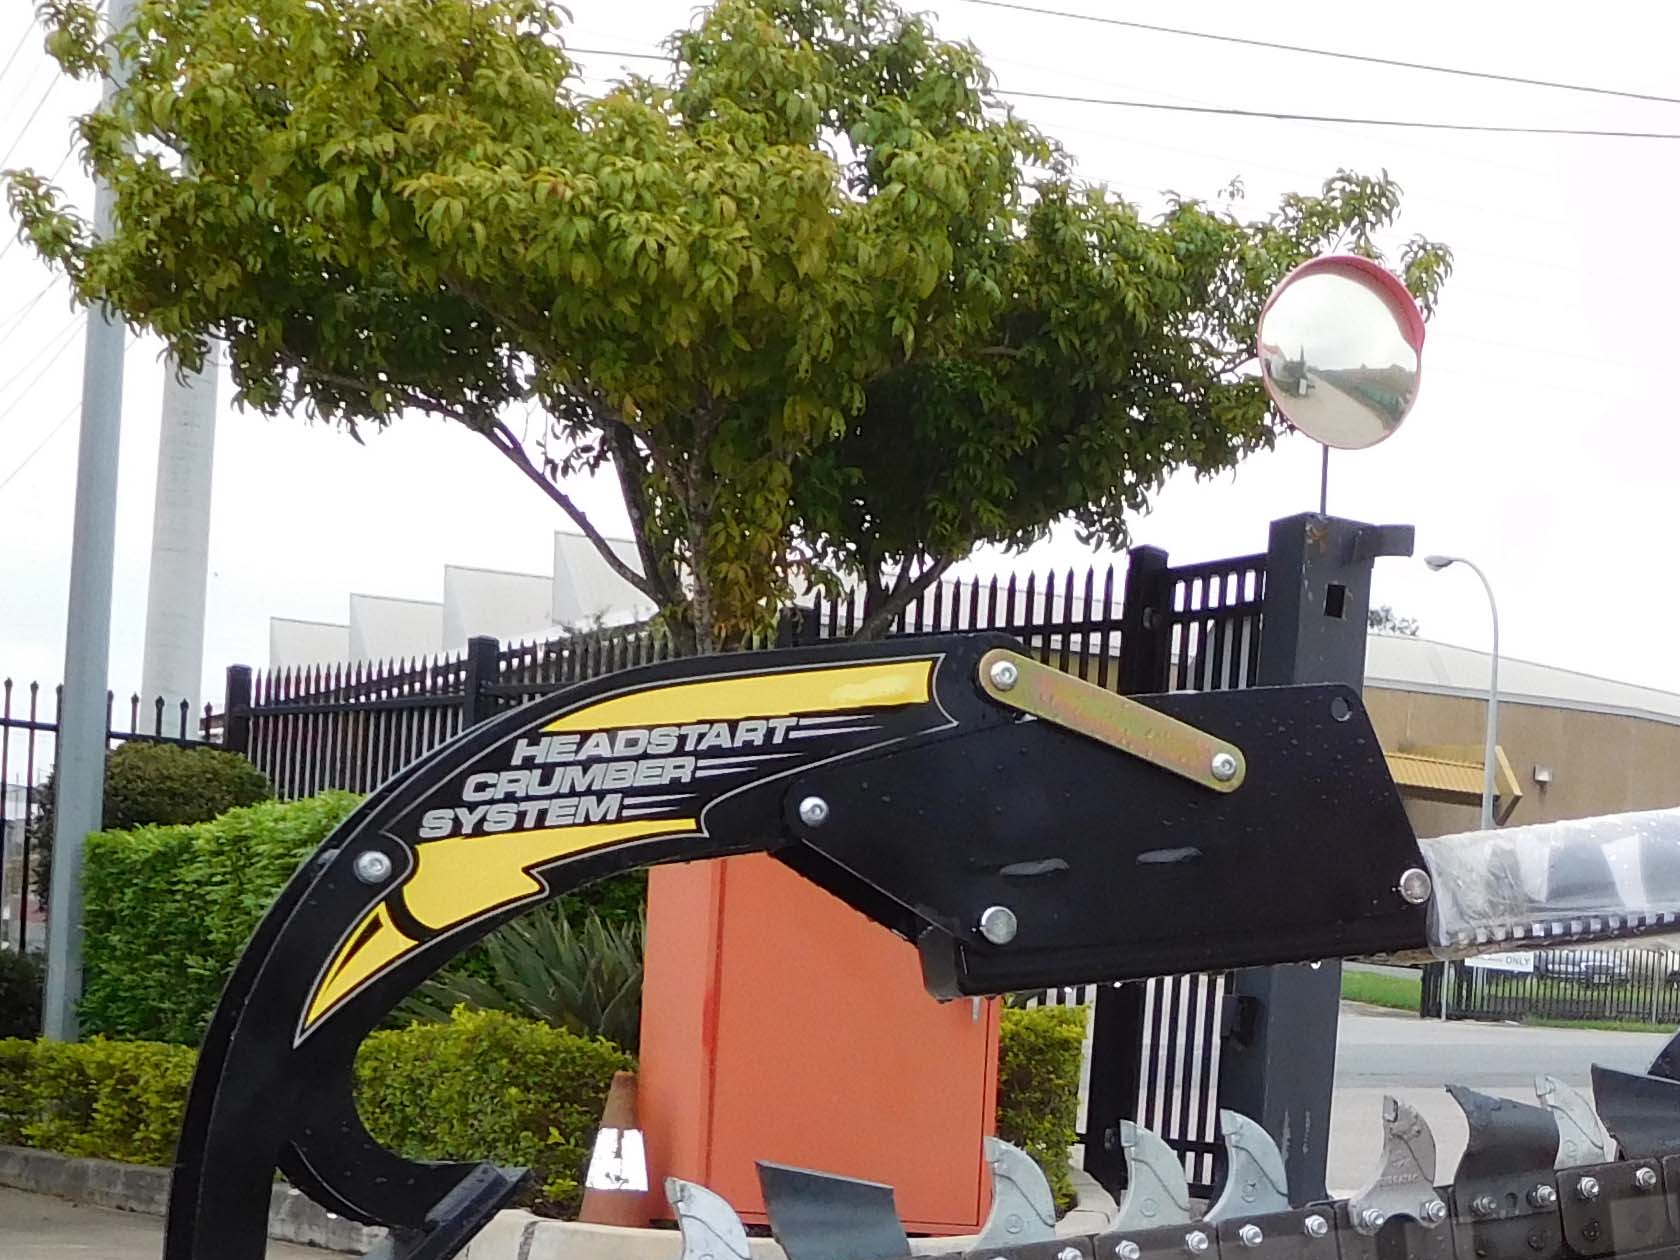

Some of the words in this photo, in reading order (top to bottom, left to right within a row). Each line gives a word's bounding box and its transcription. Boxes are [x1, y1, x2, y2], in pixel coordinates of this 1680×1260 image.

[511, 717, 799, 766] HEADSTART
[462, 756, 697, 803] CRUMBER
[419, 793, 625, 839] SYSTEM
